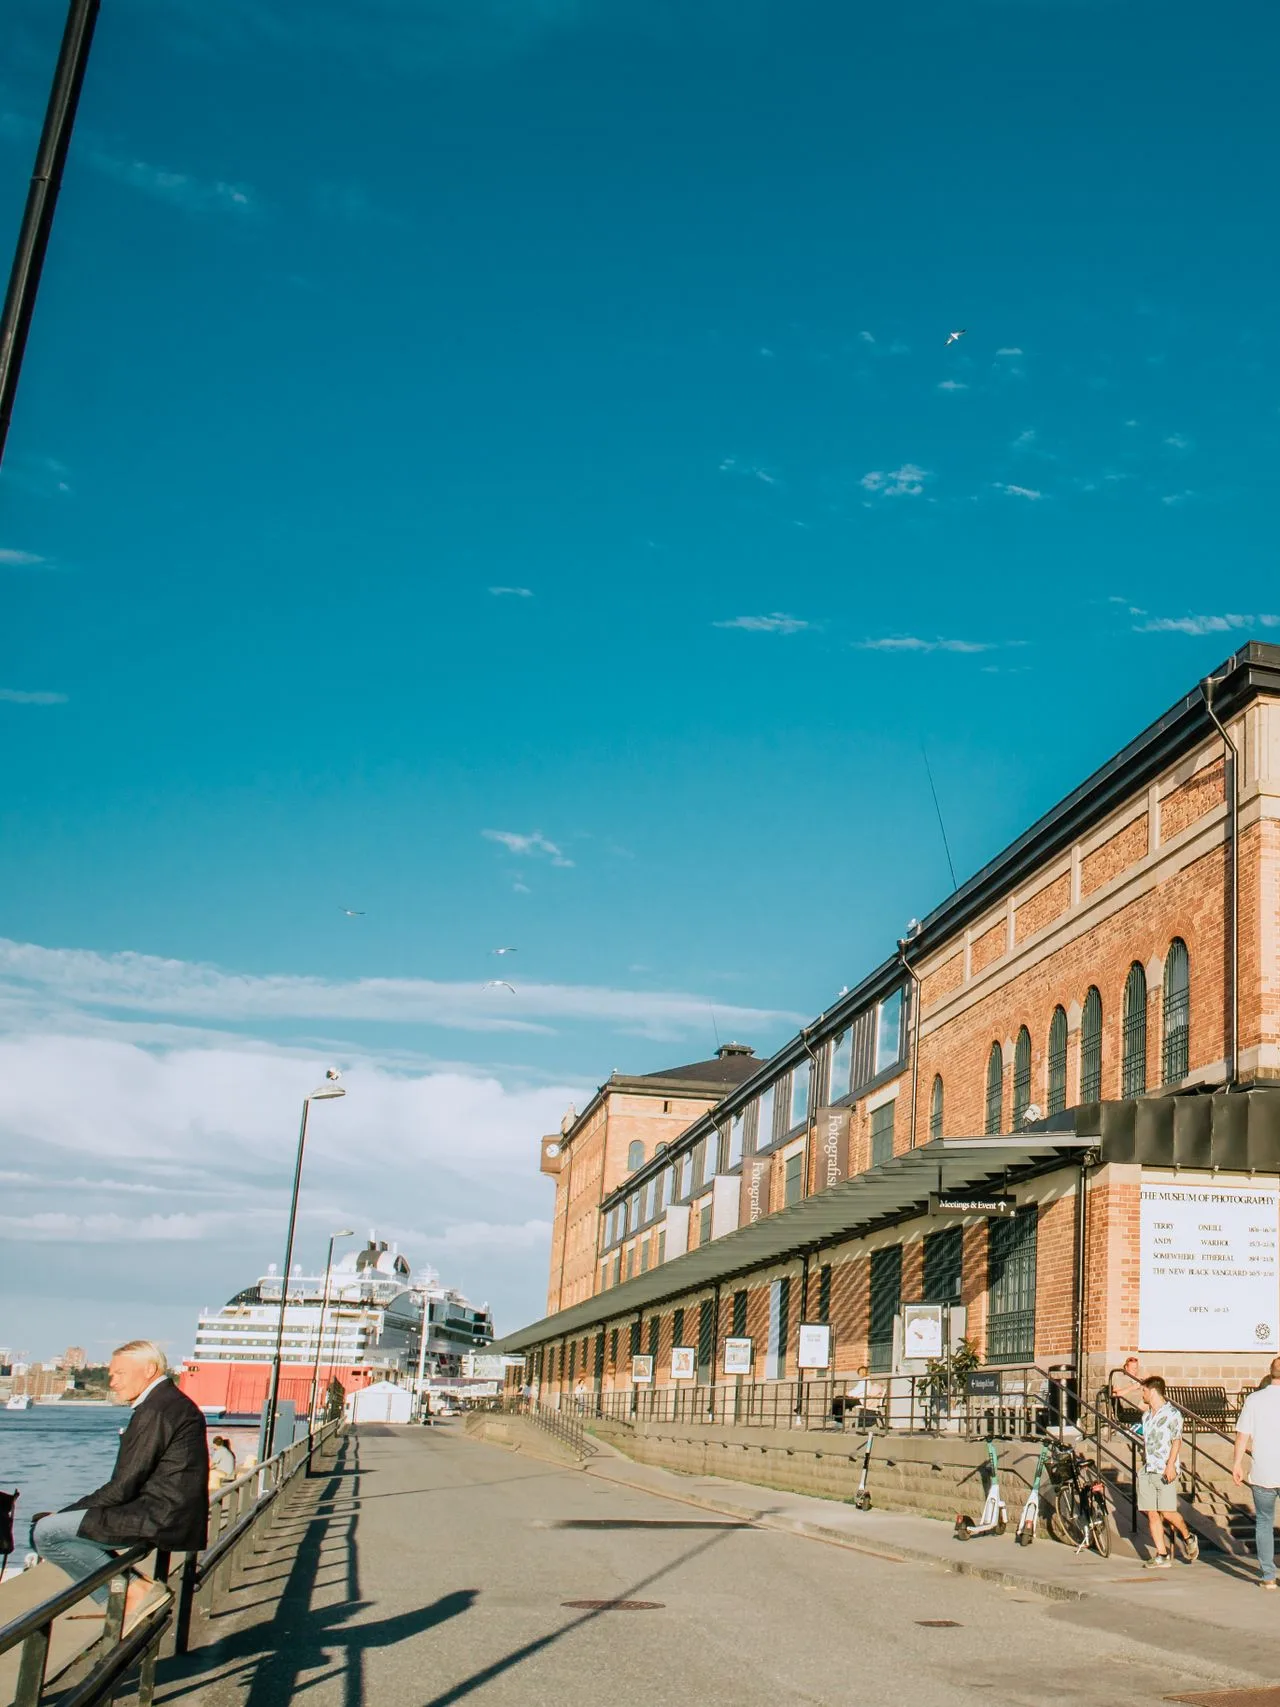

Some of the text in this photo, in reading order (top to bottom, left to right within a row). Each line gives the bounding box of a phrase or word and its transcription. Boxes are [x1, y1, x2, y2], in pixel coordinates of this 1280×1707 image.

[824, 1115, 842, 1186] Fotografis
[747, 1162, 764, 1222] Fotografis
[1140, 1191, 1275, 1205] THE MUSEUM OF PHOTOGRAPHY
[939, 1199, 997, 1211] Meetings & Event
[1153, 1222, 1174, 1230] TERRY
[1188, 1268, 1209, 1276] BLACK
[1211, 1269, 1248, 1277] VANGUARD
